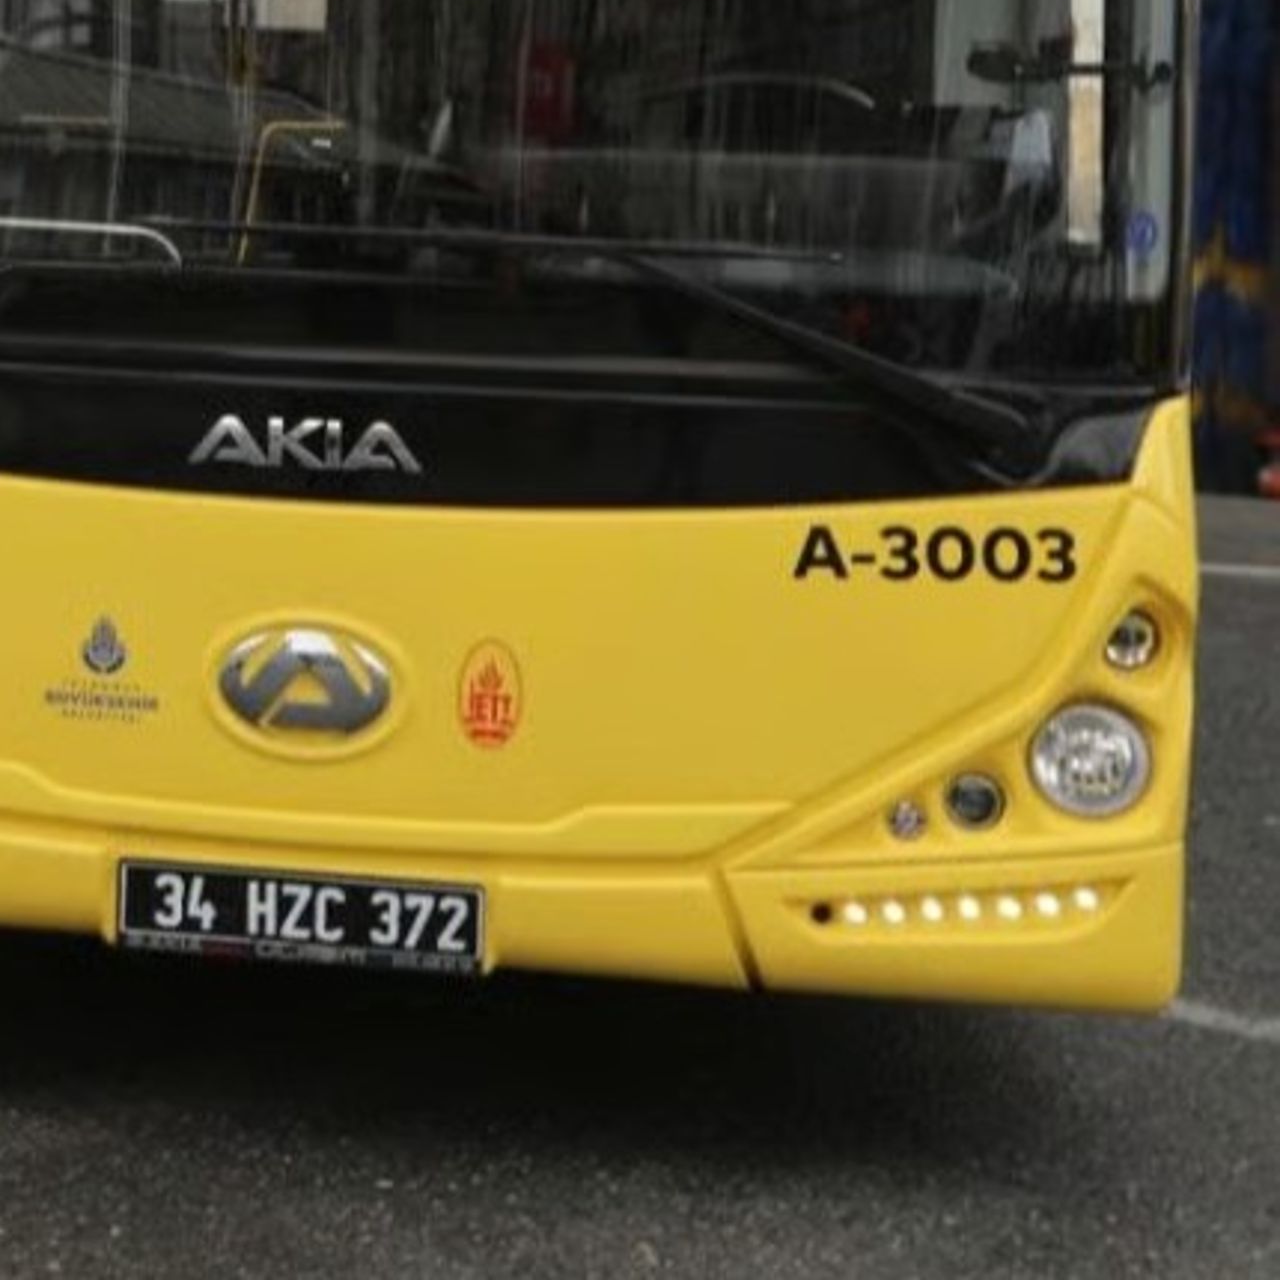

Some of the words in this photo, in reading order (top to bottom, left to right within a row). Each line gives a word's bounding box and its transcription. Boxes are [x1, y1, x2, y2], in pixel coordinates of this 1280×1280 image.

[188, 413, 422, 473] AKIA
[792, 524, 1078, 585] A-3003
[153, 873, 217, 931] 34
[246, 880, 346, 942] HZC
[369, 890, 470, 952] 372
